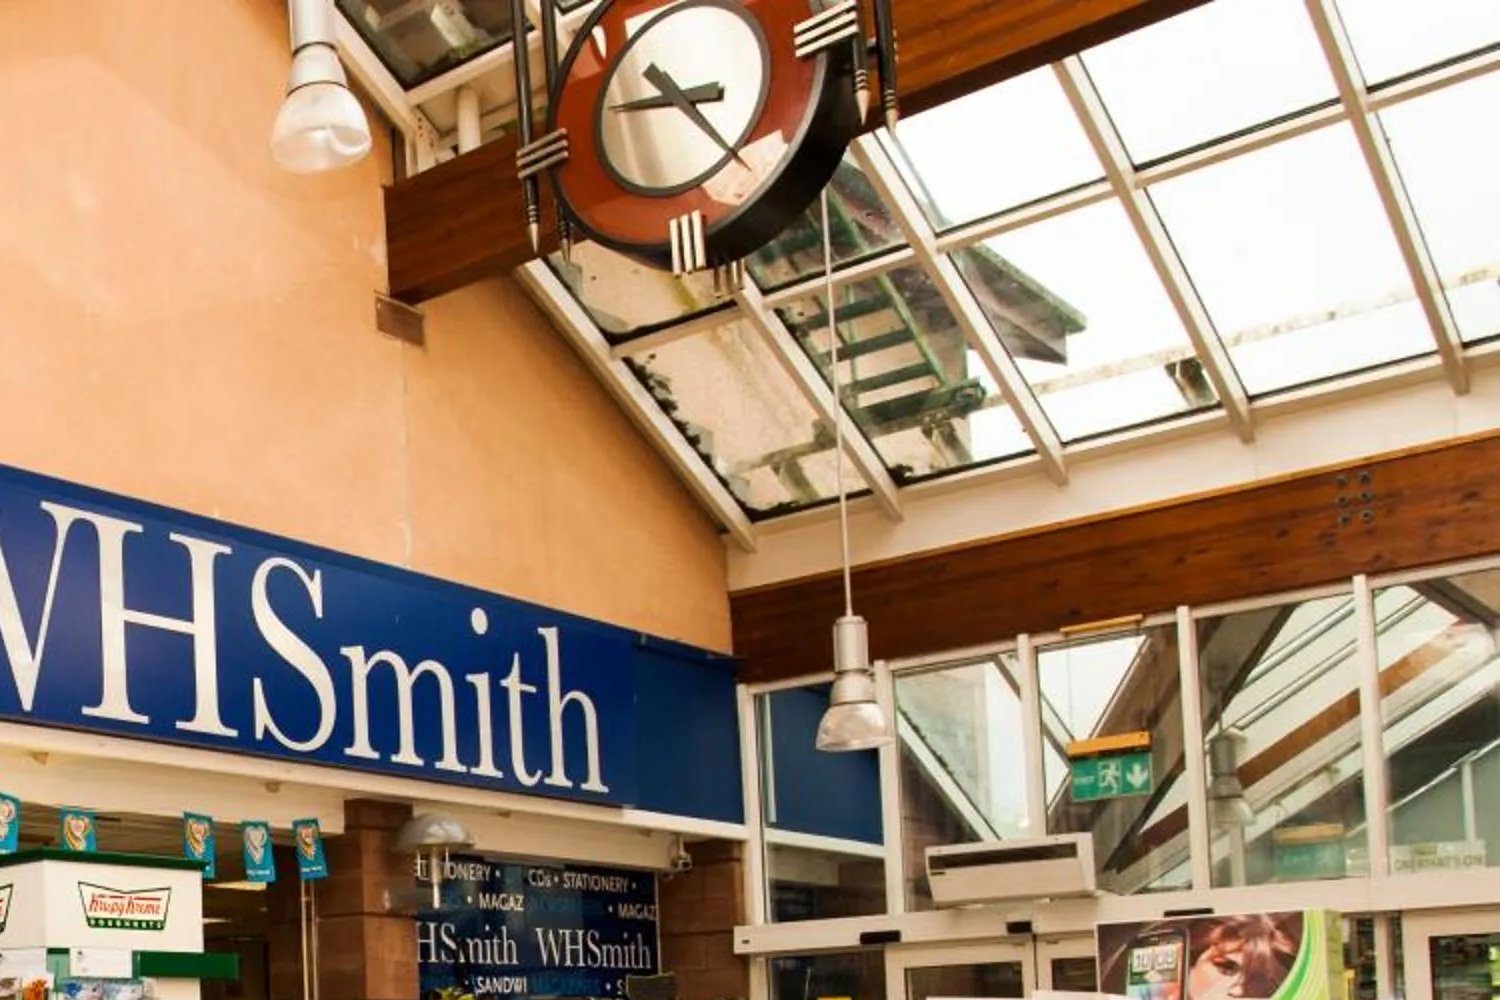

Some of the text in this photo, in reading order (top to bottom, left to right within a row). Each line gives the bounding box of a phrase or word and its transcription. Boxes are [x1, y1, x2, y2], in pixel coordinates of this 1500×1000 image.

[564, 872, 629, 893] STATIONERY
[479, 893, 525, 912] MAGAZ
[536, 926, 651, 970] WHSmith
